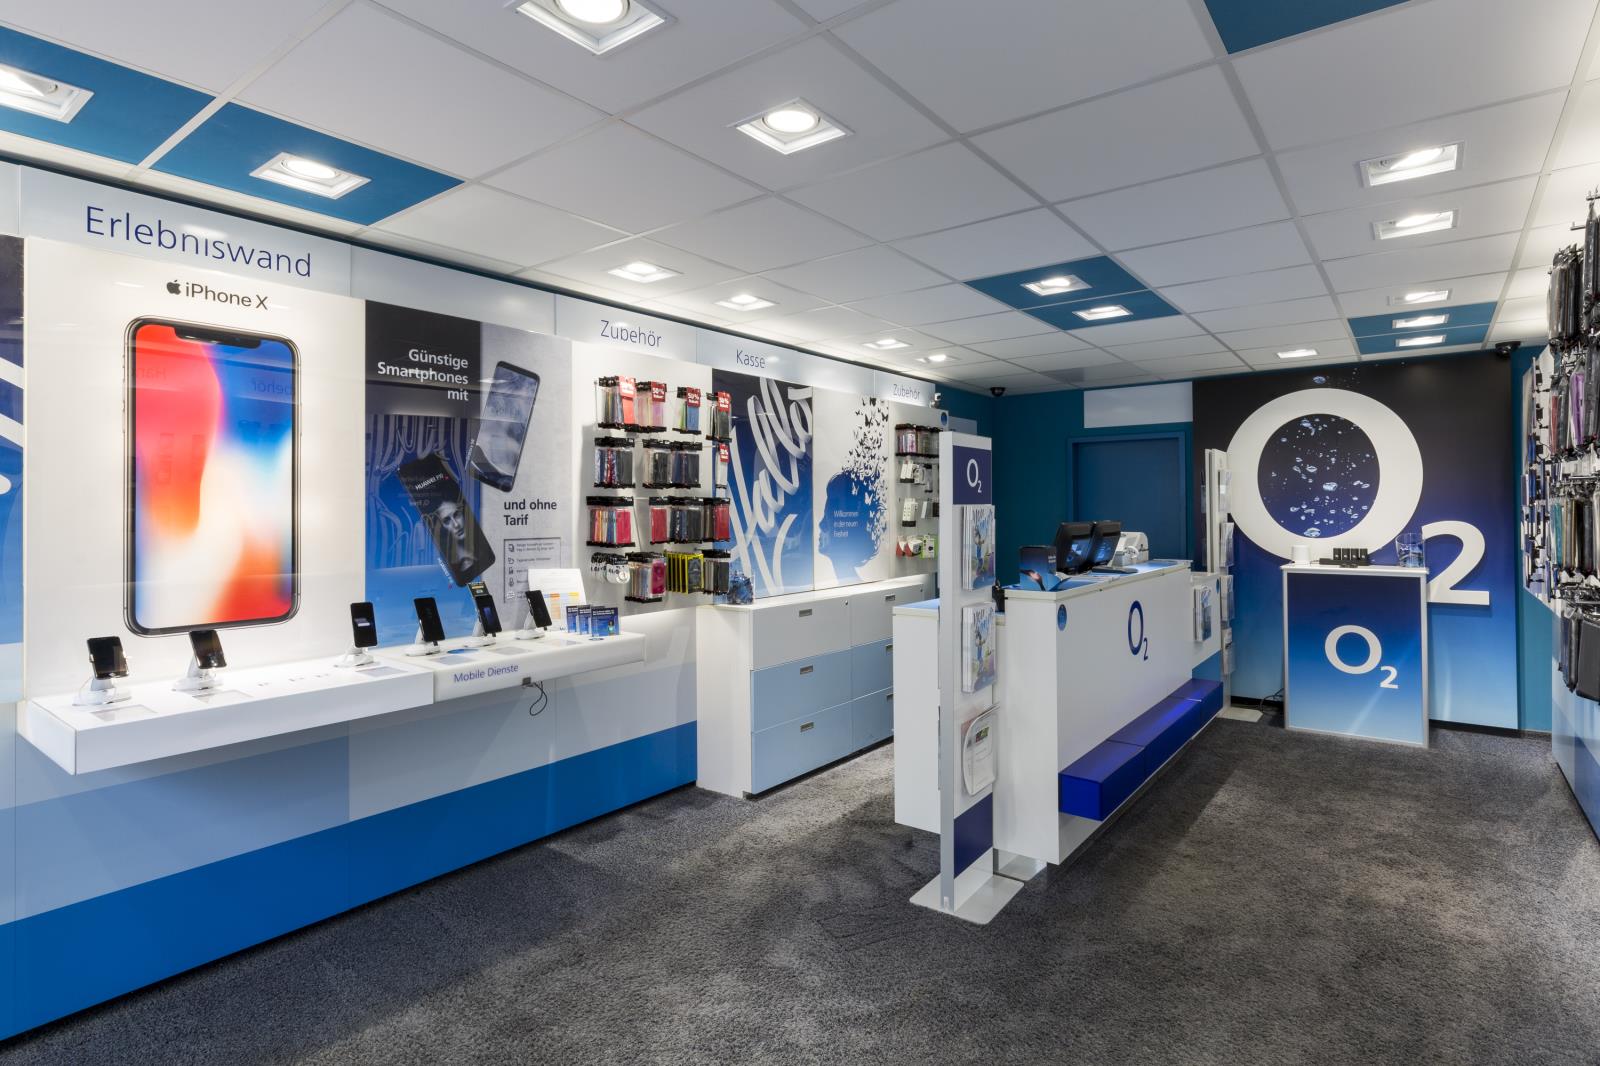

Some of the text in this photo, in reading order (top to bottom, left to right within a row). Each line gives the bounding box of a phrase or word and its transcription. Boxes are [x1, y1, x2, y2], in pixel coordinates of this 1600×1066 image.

[86, 205, 312, 278] Erlebniswand
[185, 282, 268, 310] iPhone X
[600, 319, 662, 347] Zubehör
[408, 348, 469, 370] Günstige
[736, 348, 766, 369] Kasse
[377, 361, 469, 385] Smartphones
[447, 389, 469, 401] mit
[966, 458, 982, 493] O2
[503, 498, 557, 510] und ohne
[1226, 388, 1490, 606] O2
[503, 513, 529, 526] Tarif
[1127, 600, 1149, 661] O2
[1324, 624, 1399, 689] O2
[453, 664, 519, 683] Mobile Dienste
